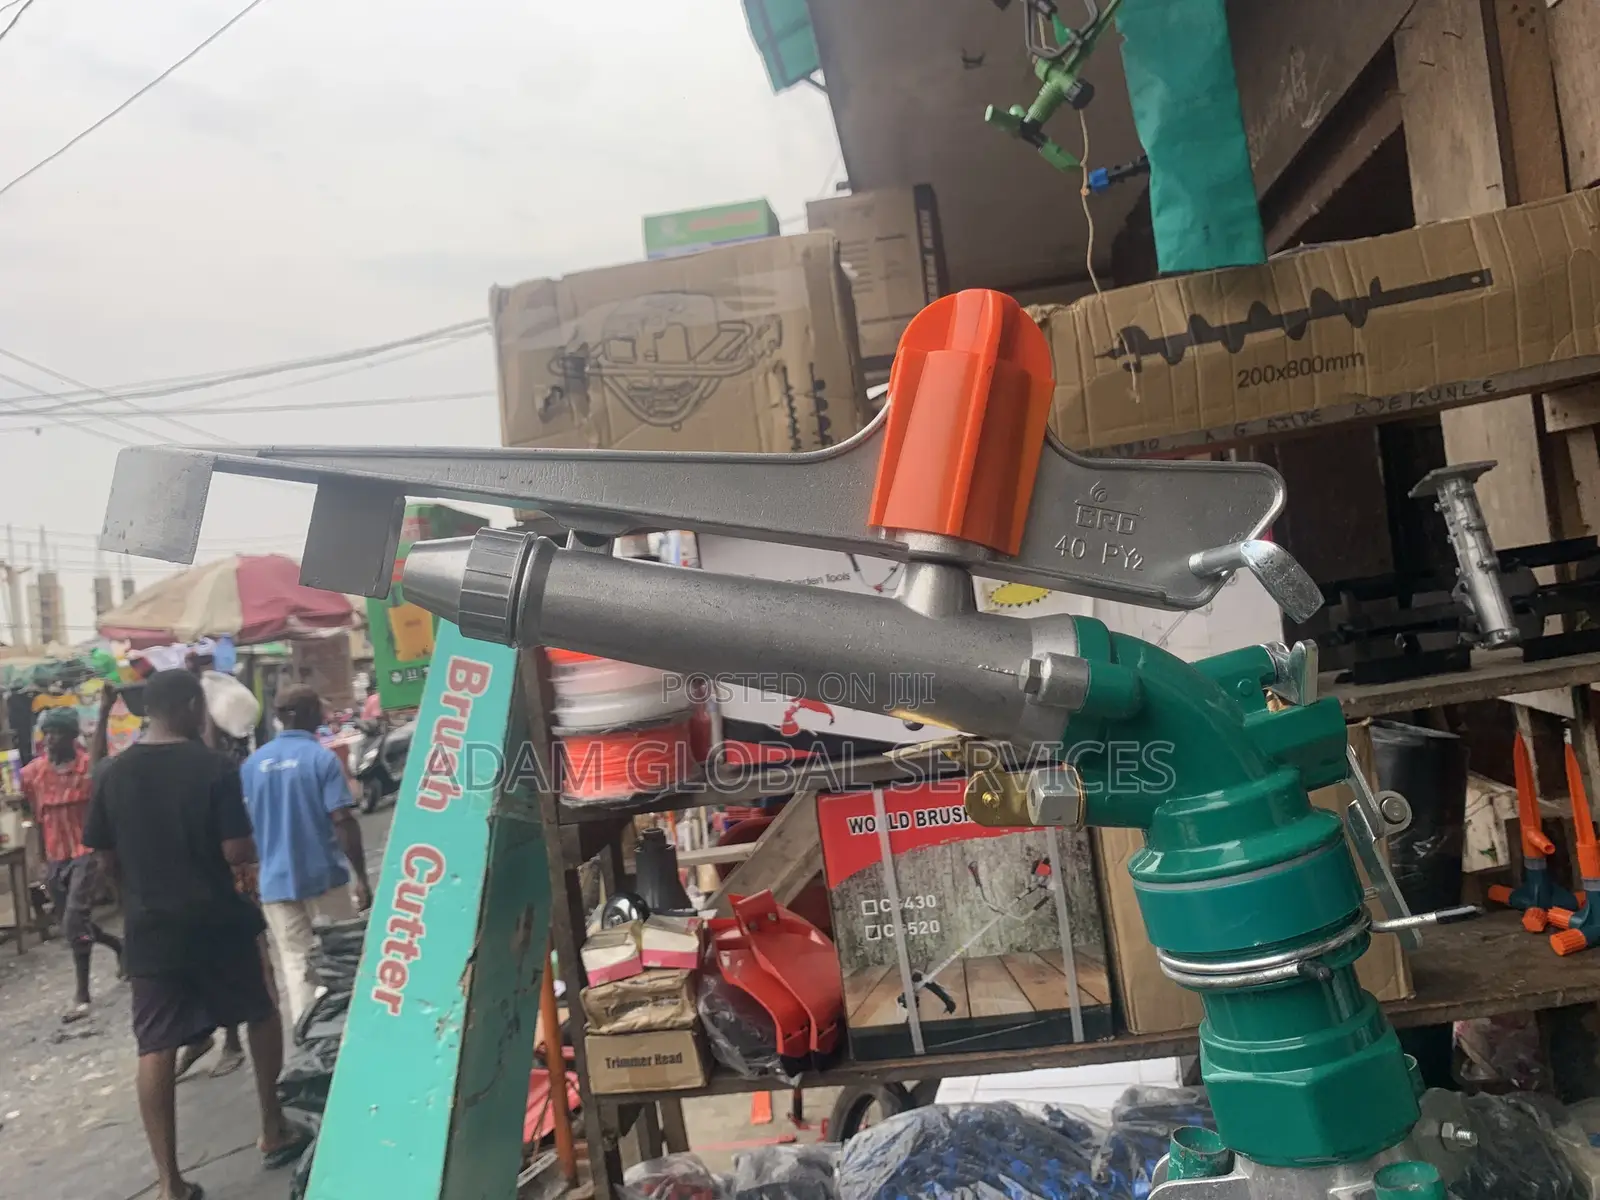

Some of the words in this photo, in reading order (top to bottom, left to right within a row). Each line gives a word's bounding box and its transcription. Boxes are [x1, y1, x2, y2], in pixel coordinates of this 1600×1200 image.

[1237, 351, 1365, 389] 200x800mm
[1054, 534, 1087, 560] 40
[847, 811, 910, 836] WOLD
[372, 843, 446, 1016] Cutter
